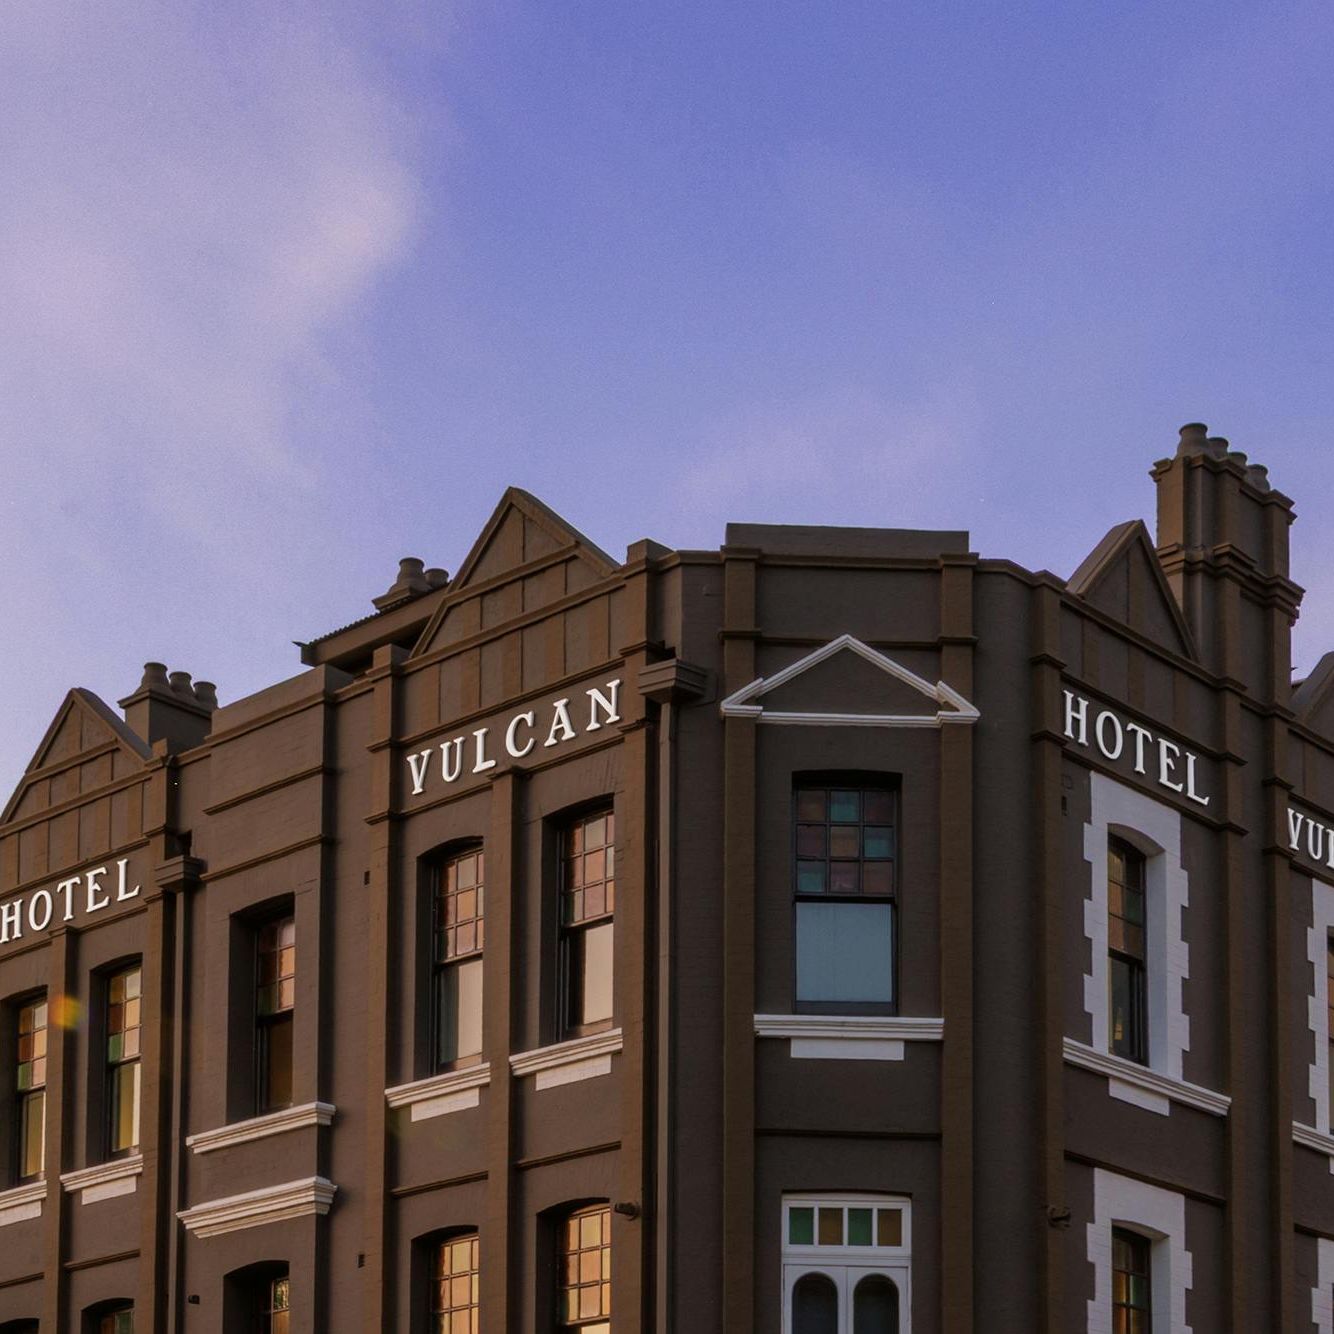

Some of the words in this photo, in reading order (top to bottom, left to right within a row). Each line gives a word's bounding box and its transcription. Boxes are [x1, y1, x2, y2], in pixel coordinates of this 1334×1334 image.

[406, 679, 621, 795] VULCAN
[1063, 689, 1210, 806] HOTEL
[0, 858, 140, 944] HOTEL
